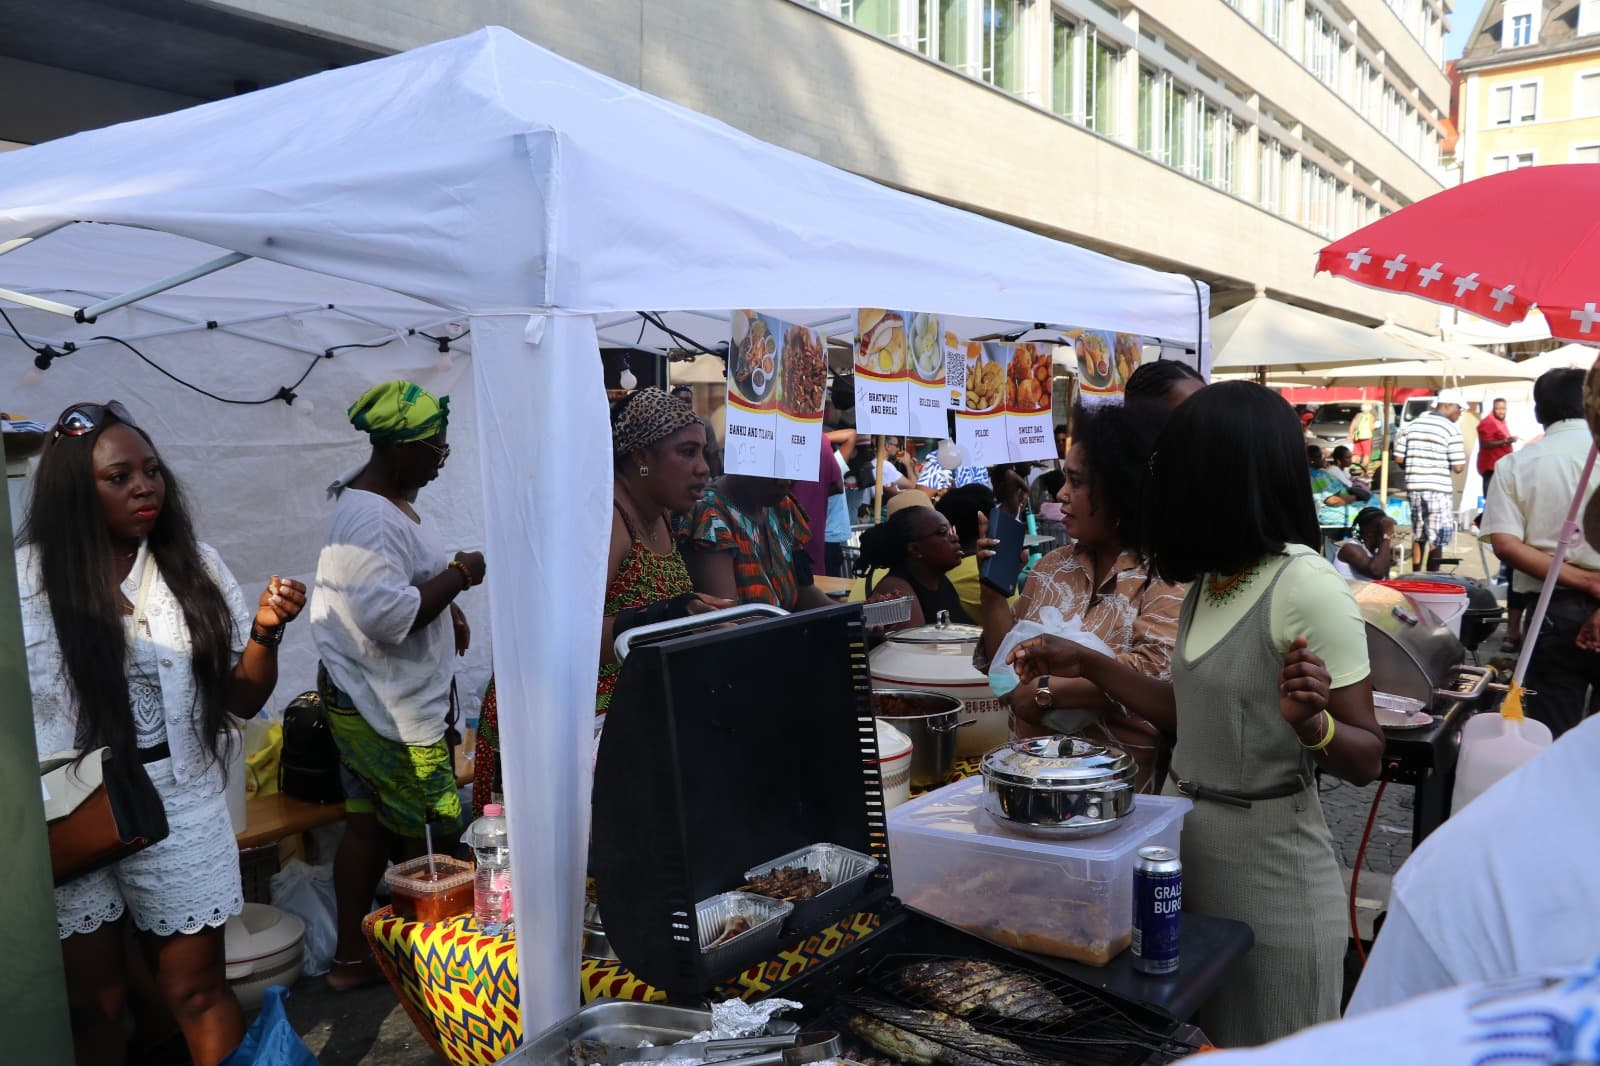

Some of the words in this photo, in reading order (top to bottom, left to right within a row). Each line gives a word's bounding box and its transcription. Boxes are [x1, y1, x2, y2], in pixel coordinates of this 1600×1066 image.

[868, 392, 898, 404] BRATWURST
[870, 405, 881, 414] AND
[729, 424, 747, 436] BANKU
[747, 427, 757, 438] AND
[758, 428, 774, 440] TILAPIA
[791, 434, 806, 446] KEBAB
